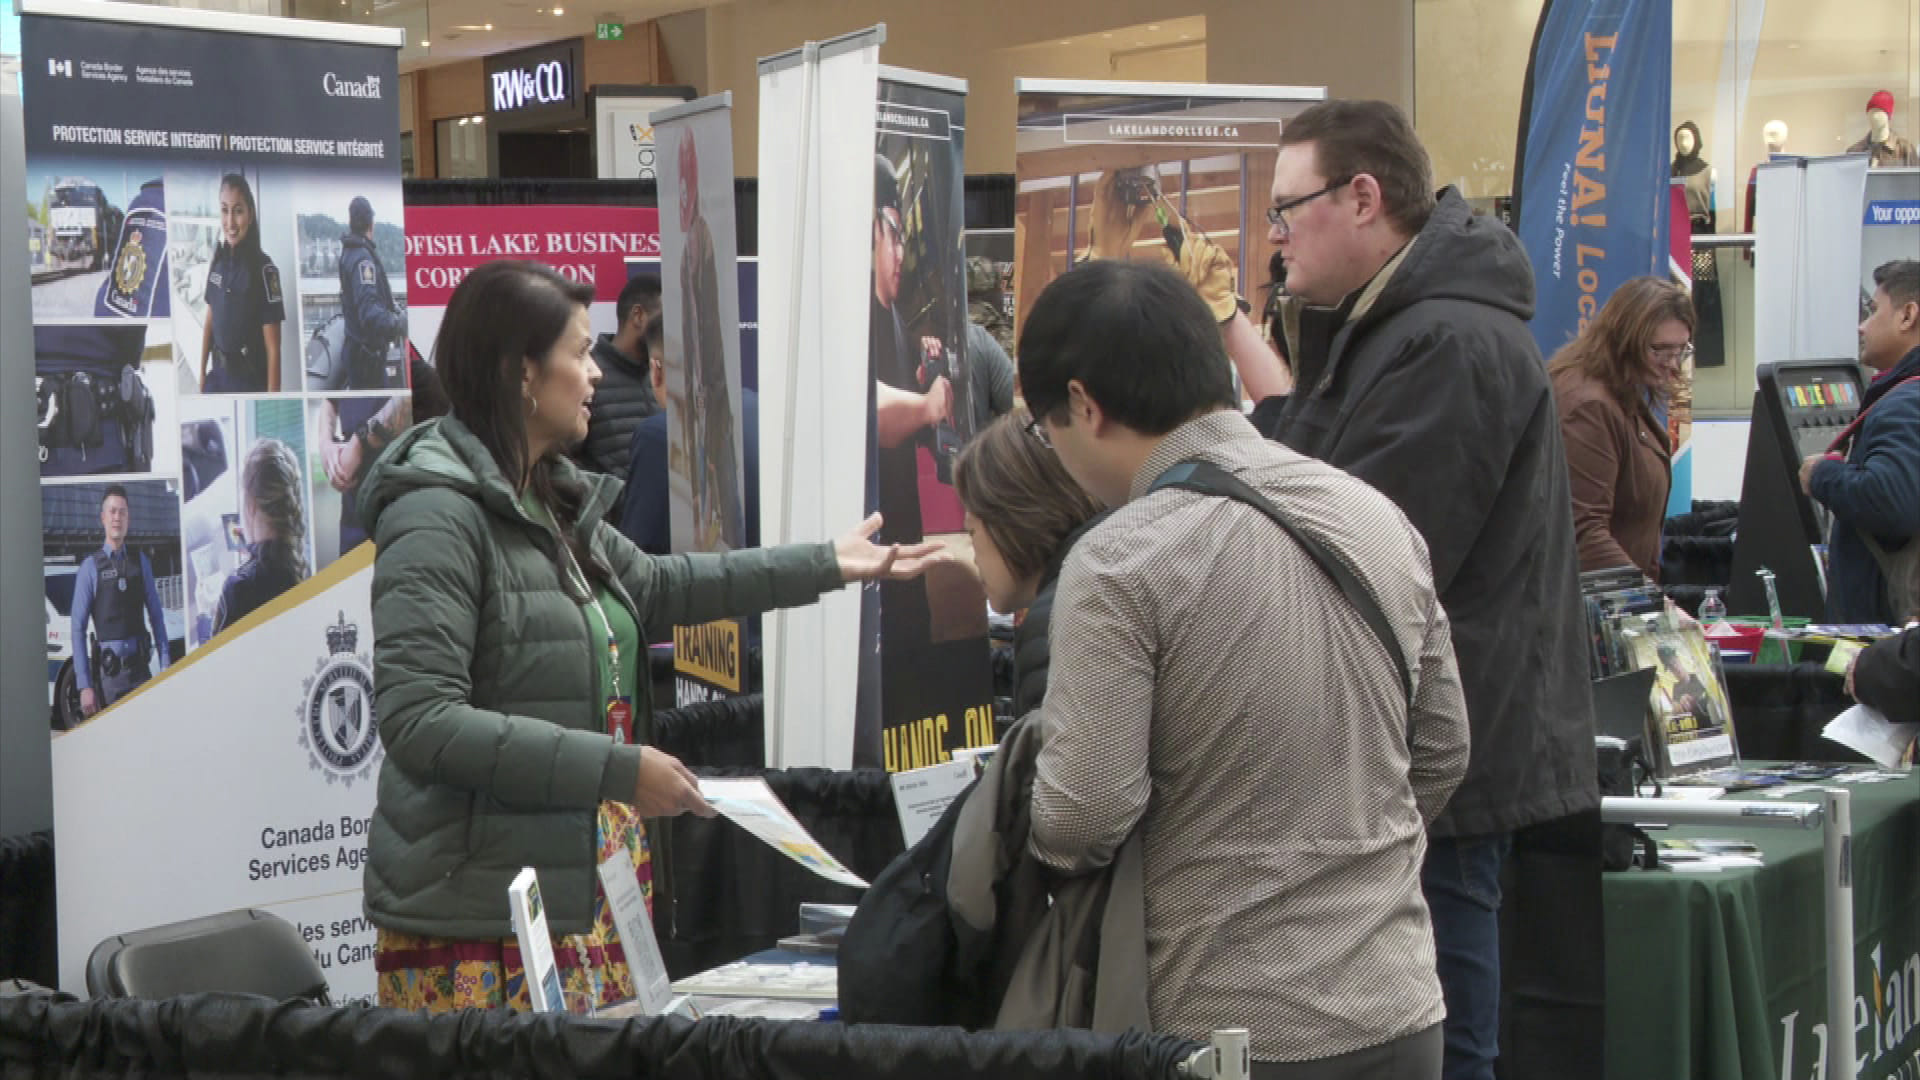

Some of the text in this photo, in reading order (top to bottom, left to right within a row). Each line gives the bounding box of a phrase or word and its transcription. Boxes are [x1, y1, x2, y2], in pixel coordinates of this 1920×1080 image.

[323, 72, 381, 99] Canada
[52, 125, 384, 158] PROTECTION SERVICE INTEGRITY PROTECTION SERVICE INTÉGRITÉ
[1108, 124, 1239, 137] LAKELANDCOLLEGE.CA
[1557, 198, 1567, 225] the
[1872, 205, 1893, 221] Your
[469, 234, 540, 255] LAKE
[1552, 227, 1566, 279] Power
[676, 624, 736, 679] TRAINING
[261, 820, 334, 849] Canada
[248, 845, 369, 881] Services Age
